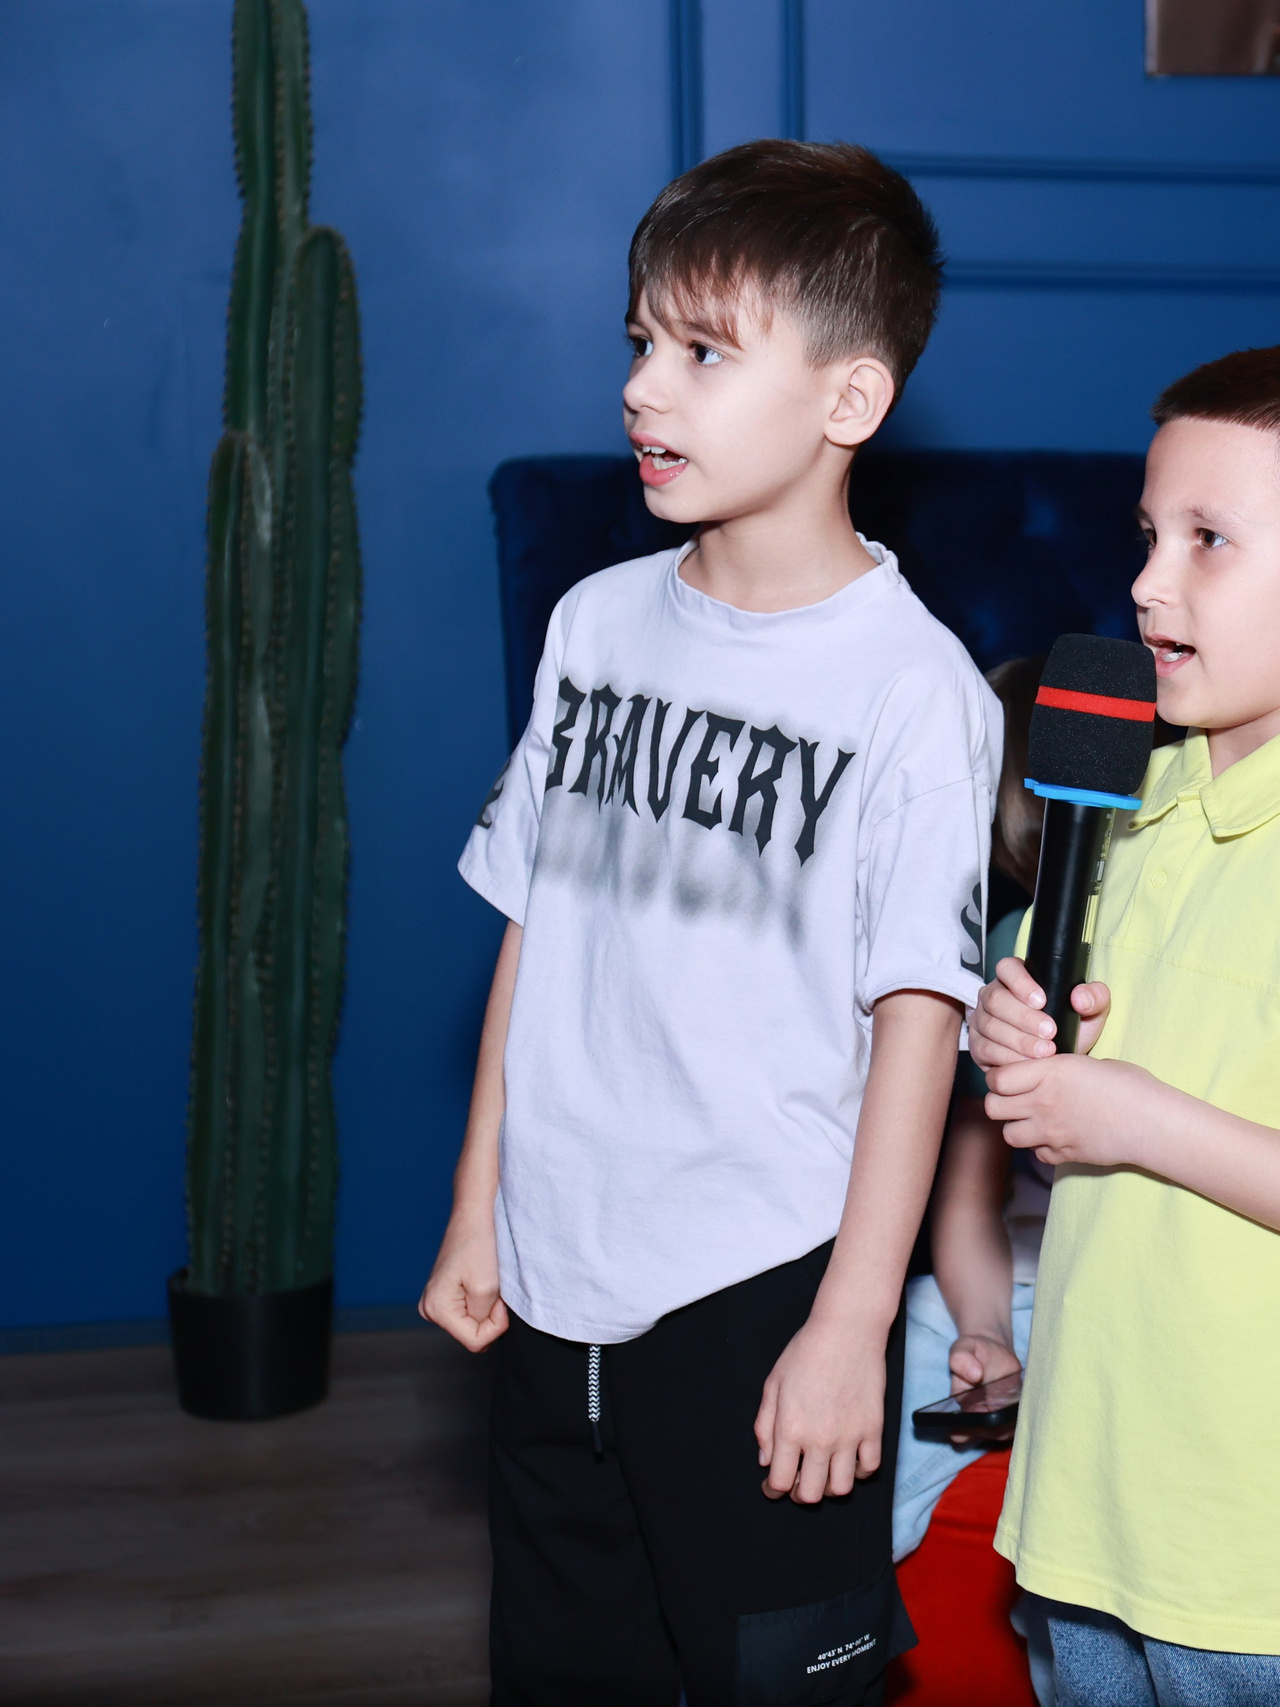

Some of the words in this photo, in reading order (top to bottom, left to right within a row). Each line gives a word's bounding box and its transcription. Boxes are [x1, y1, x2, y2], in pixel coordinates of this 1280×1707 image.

[544, 675, 856, 867] BRAVERY
[806, 1661, 830, 1674] ENJOY
[831, 1652, 851, 1667] EVERY
[851, 1638, 876, 1658] MOMENT
